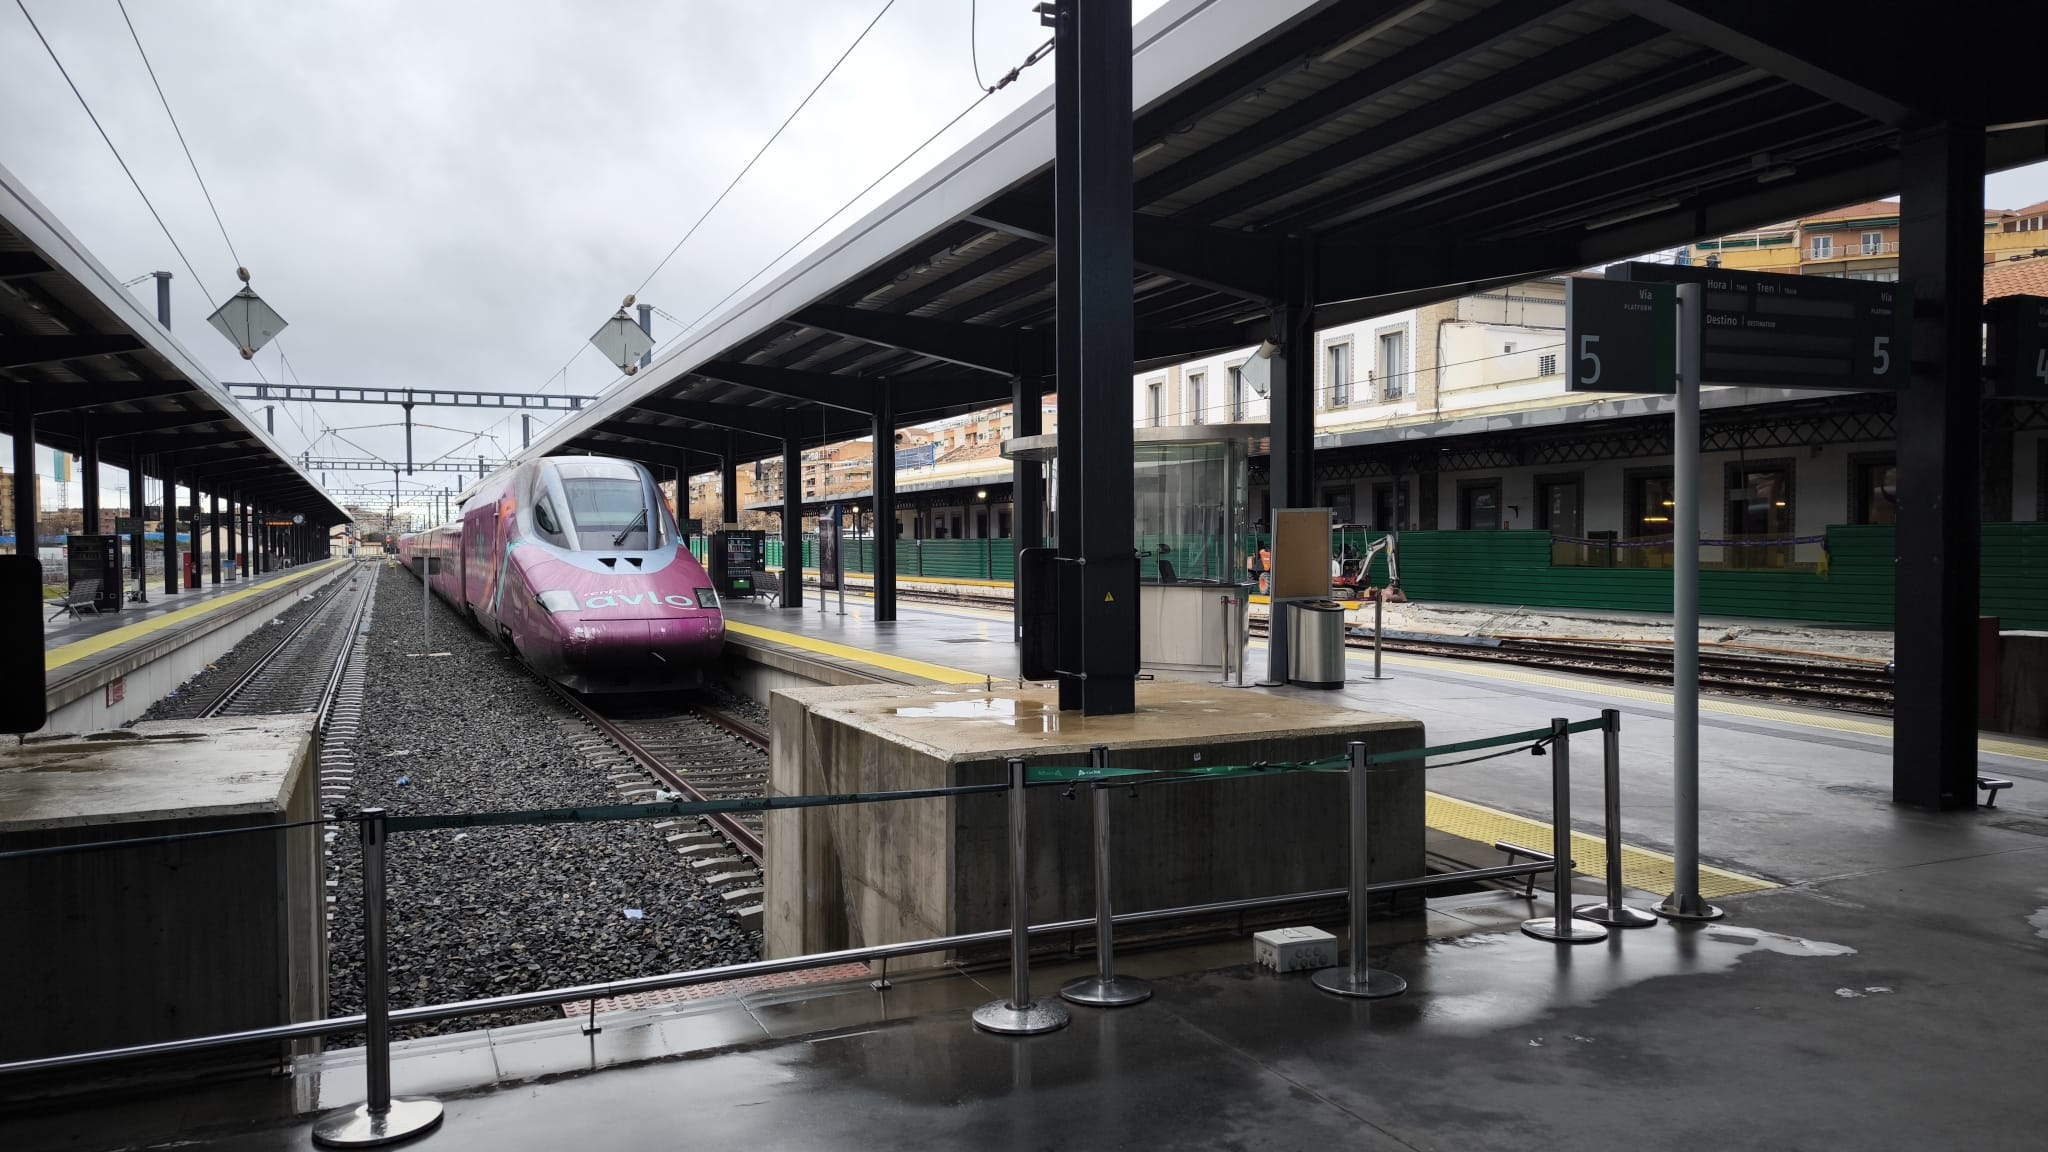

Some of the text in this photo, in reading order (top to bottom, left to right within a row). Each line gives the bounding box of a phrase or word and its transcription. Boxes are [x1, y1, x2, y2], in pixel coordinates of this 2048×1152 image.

[1707, 279, 1727, 290] Hora
[1757, 282, 1775, 294] Tren
[1624, 303, 1653, 312] PLATFORM
[1706, 314, 1738, 326] Destino
[1580, 334, 1601, 384] 5
[1872, 336, 1890, 375] 5
[586, 591, 693, 609] avlo
